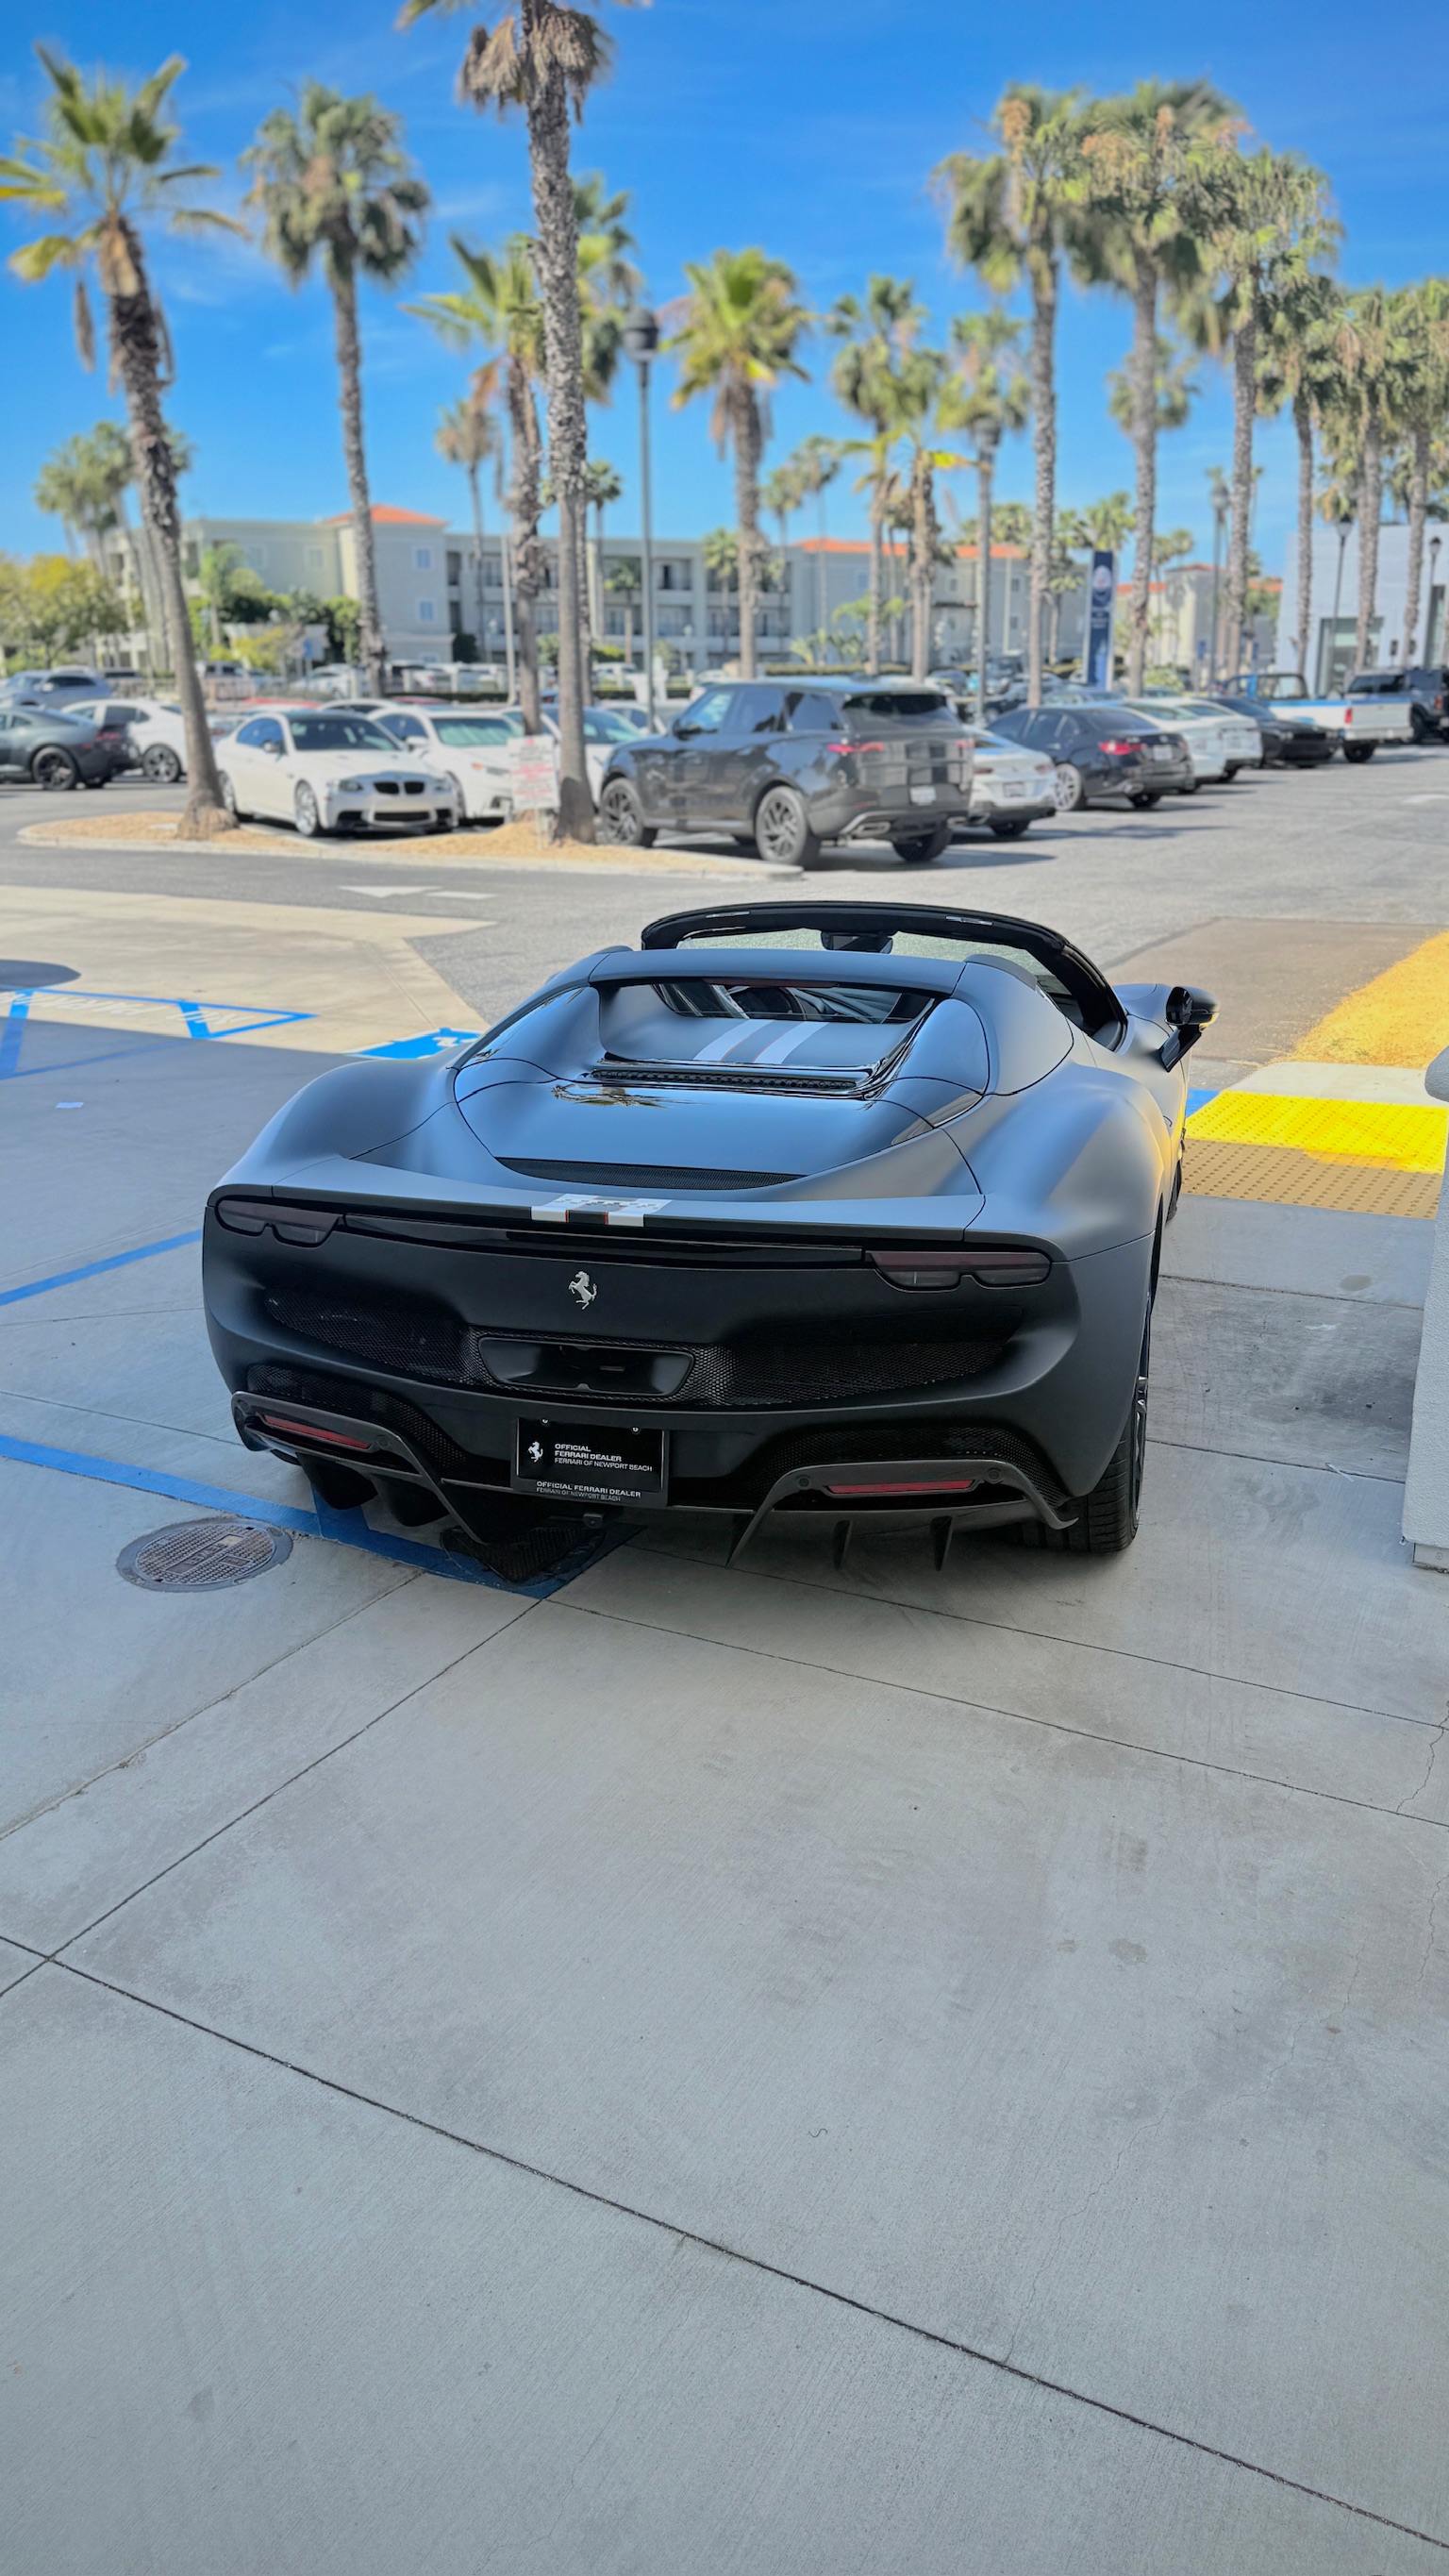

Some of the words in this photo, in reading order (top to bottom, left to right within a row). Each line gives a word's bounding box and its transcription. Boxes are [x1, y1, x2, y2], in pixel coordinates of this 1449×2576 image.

[555, 1443, 591, 1452] OFFICIAL
[555, 1450, 589, 1460] FERRARI
[590, 1454, 622, 1463] DEALER
[555, 1457, 583, 1465] FERRARI
[593, 1461, 628, 1470] NEWPORT
[629, 1464, 653, 1472] BEACH
[536, 1480, 573, 1491] OFFICIAL
[574, 1484, 608, 1495] FERRARI
[609, 1488, 641, 1497] DEALER
[571, 1491, 600, 1500] NEWPORT
